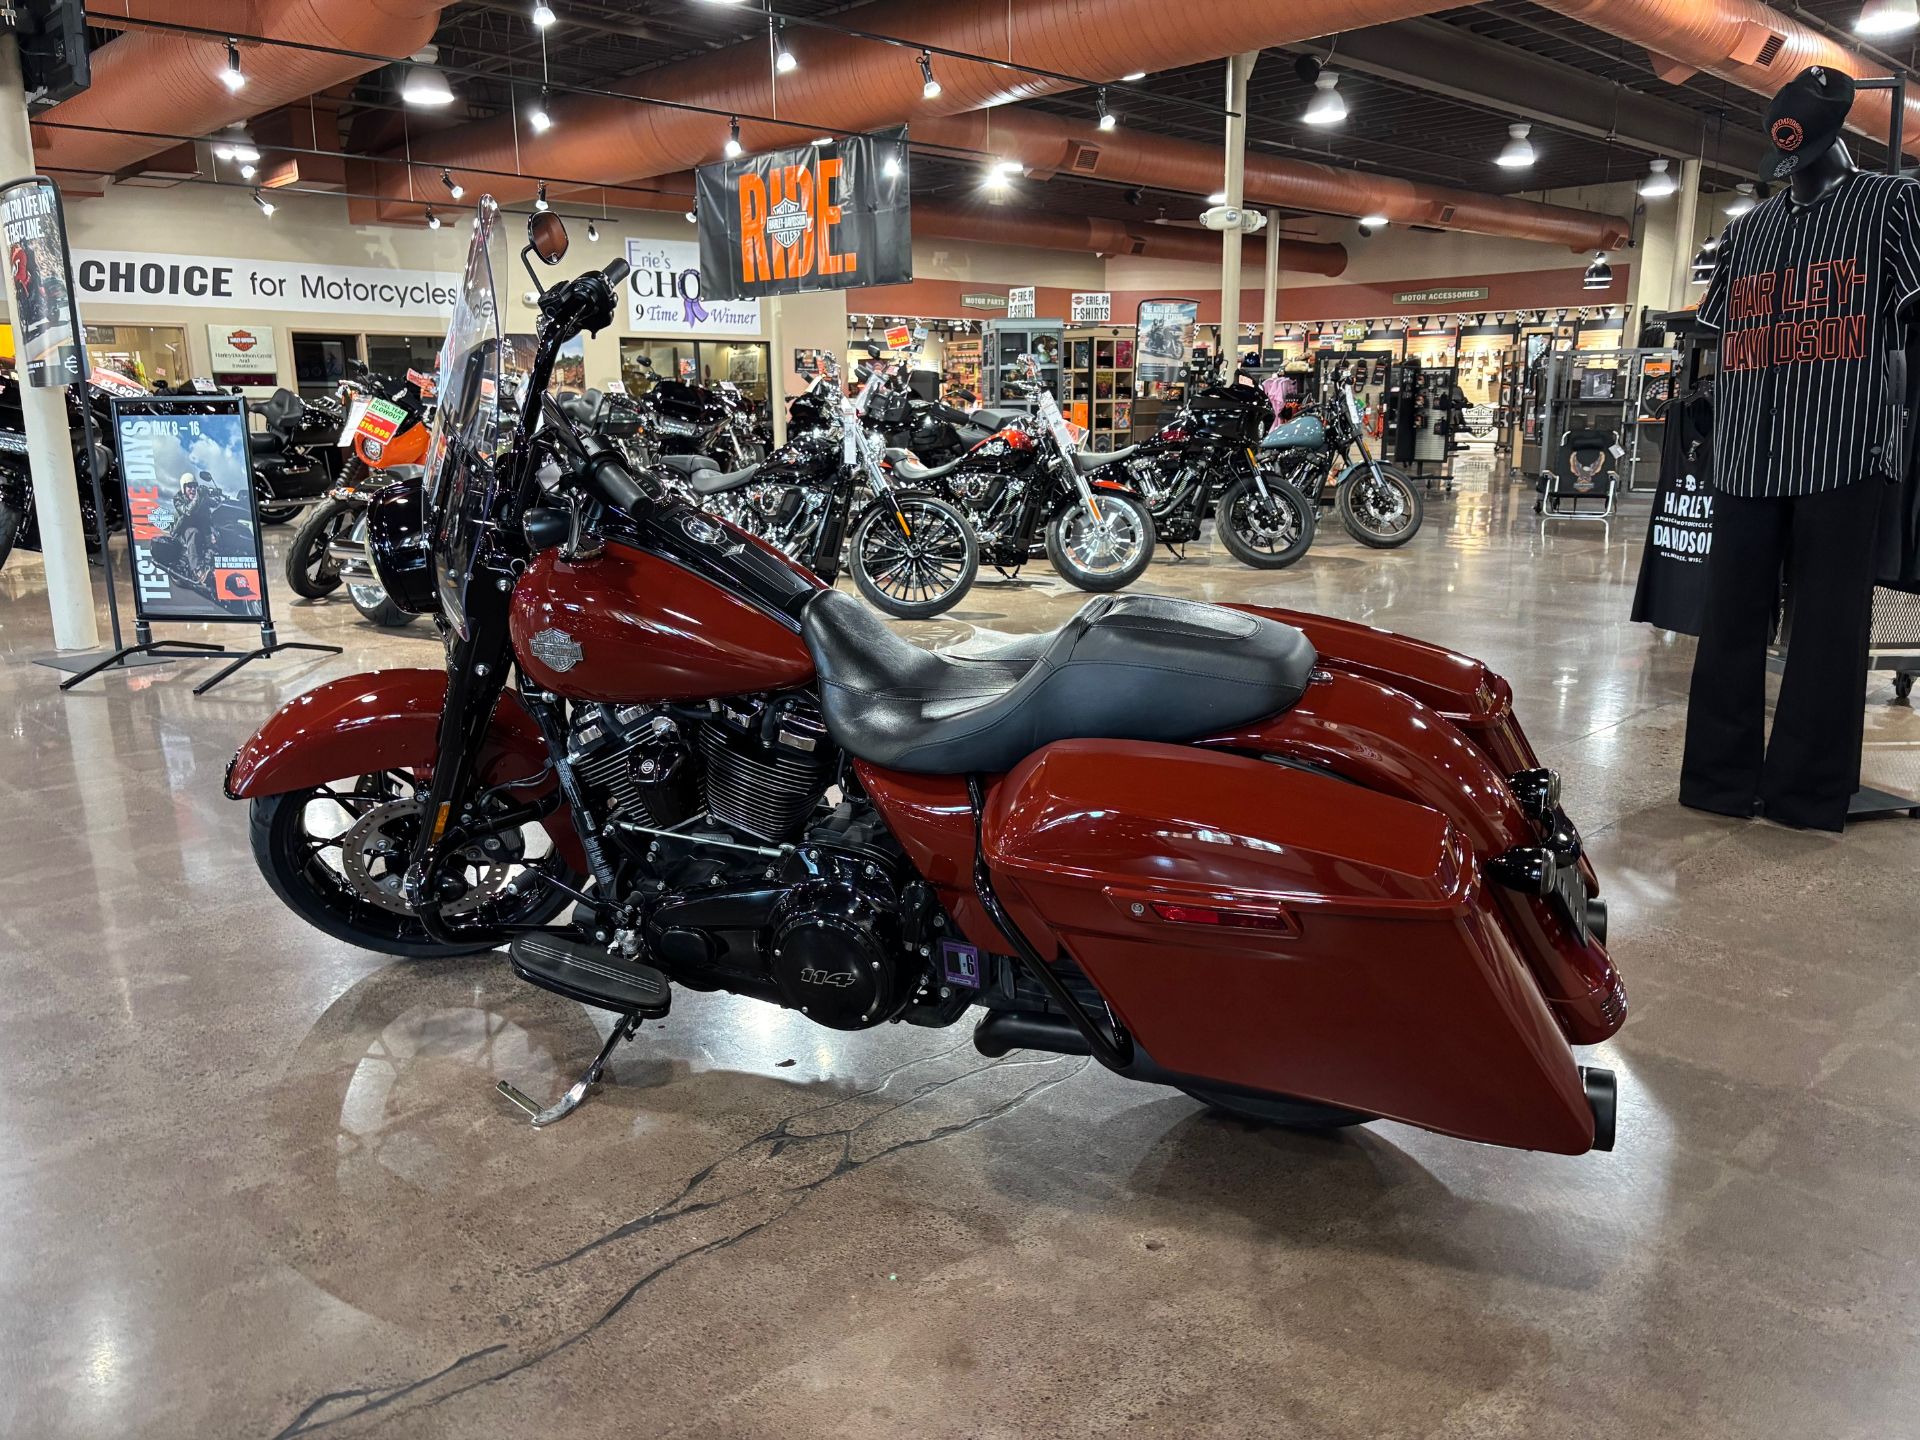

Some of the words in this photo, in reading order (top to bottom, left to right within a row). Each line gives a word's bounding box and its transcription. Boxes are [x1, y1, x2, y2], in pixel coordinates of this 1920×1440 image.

[22, 194, 39, 217] LIFE
[38, 193, 51, 215] IN
[739, 158, 857, 283] RIDE.
[628, 240, 671, 269] Erie's
[79, 260, 233, 297] CHOICE
[250, 271, 287, 297] for
[301, 275, 457, 308] Motorcycles
[631, 269, 701, 299] CHO
[965, 297, 986, 305] MOTOR
[986, 297, 1006, 306] PARTS
[1085, 295, 1100, 306] ERIE,
[1101, 295, 1109, 305] PA
[1401, 293, 1427, 302] MOTOR
[1428, 289, 1480, 300] ACCESSORIES
[636, 303, 645, 320] 9
[647, 304, 678, 321] Time
[711, 306, 757, 325] Winner
[1073, 307, 1109, 320] T-SHIRTS
[1346, 328, 1361, 337] PETS
[371, 403, 402, 421] BLOWOUT
[152, 421, 172, 436] MAY
[171, 421, 178, 436] 8
[189, 422, 200, 436] 16
[121, 420, 156, 480] DAYS
[134, 545, 172, 603] TEST
[801, 968, 855, 987] 114
